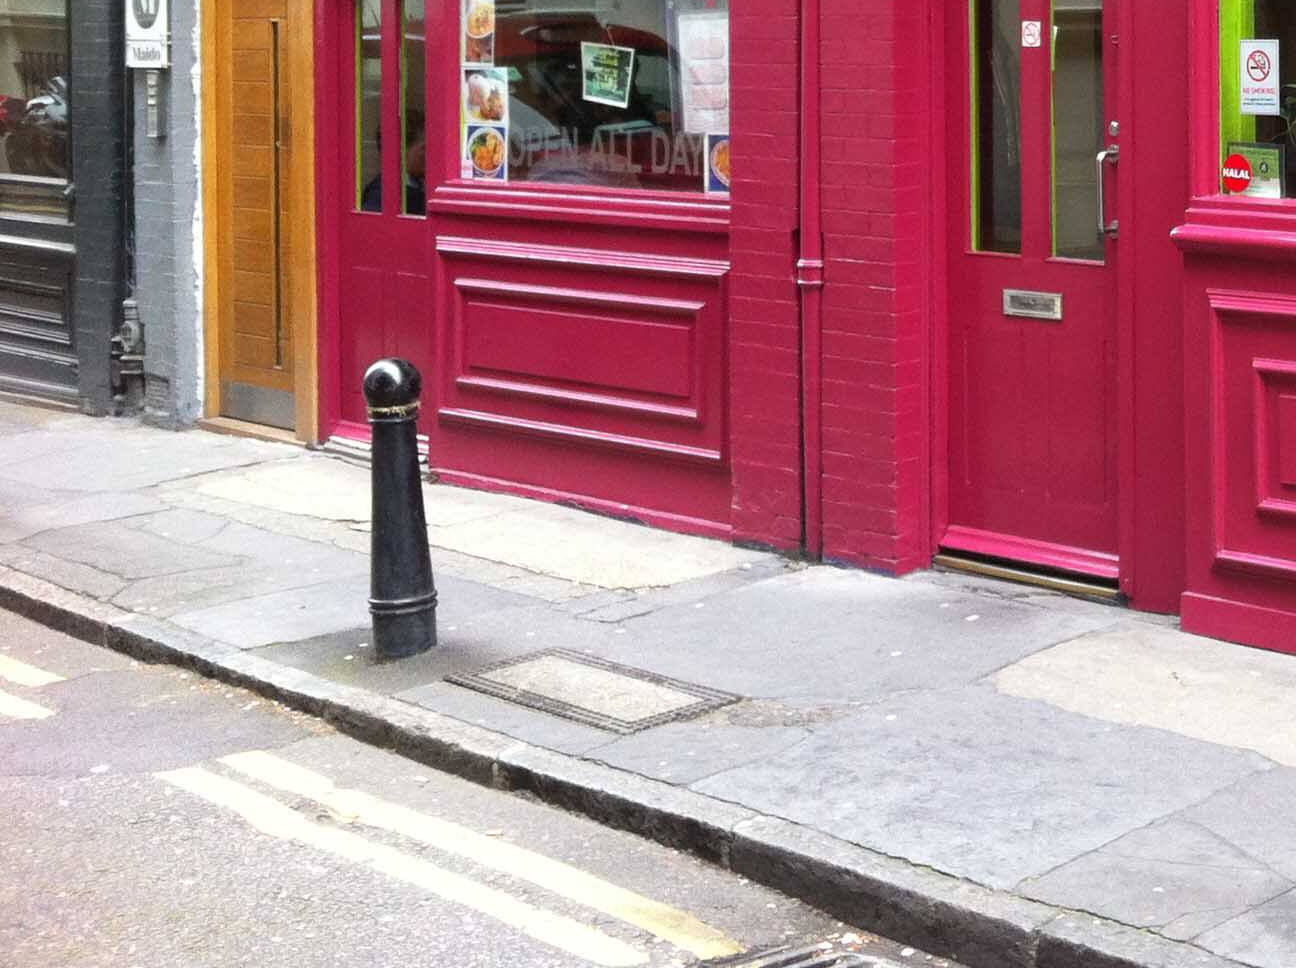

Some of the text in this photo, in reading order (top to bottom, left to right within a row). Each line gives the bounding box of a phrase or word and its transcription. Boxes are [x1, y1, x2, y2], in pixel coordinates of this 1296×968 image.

[509, 126, 705, 176] OPEN ALL DAY
[1223, 168, 1250, 179] HALAL
